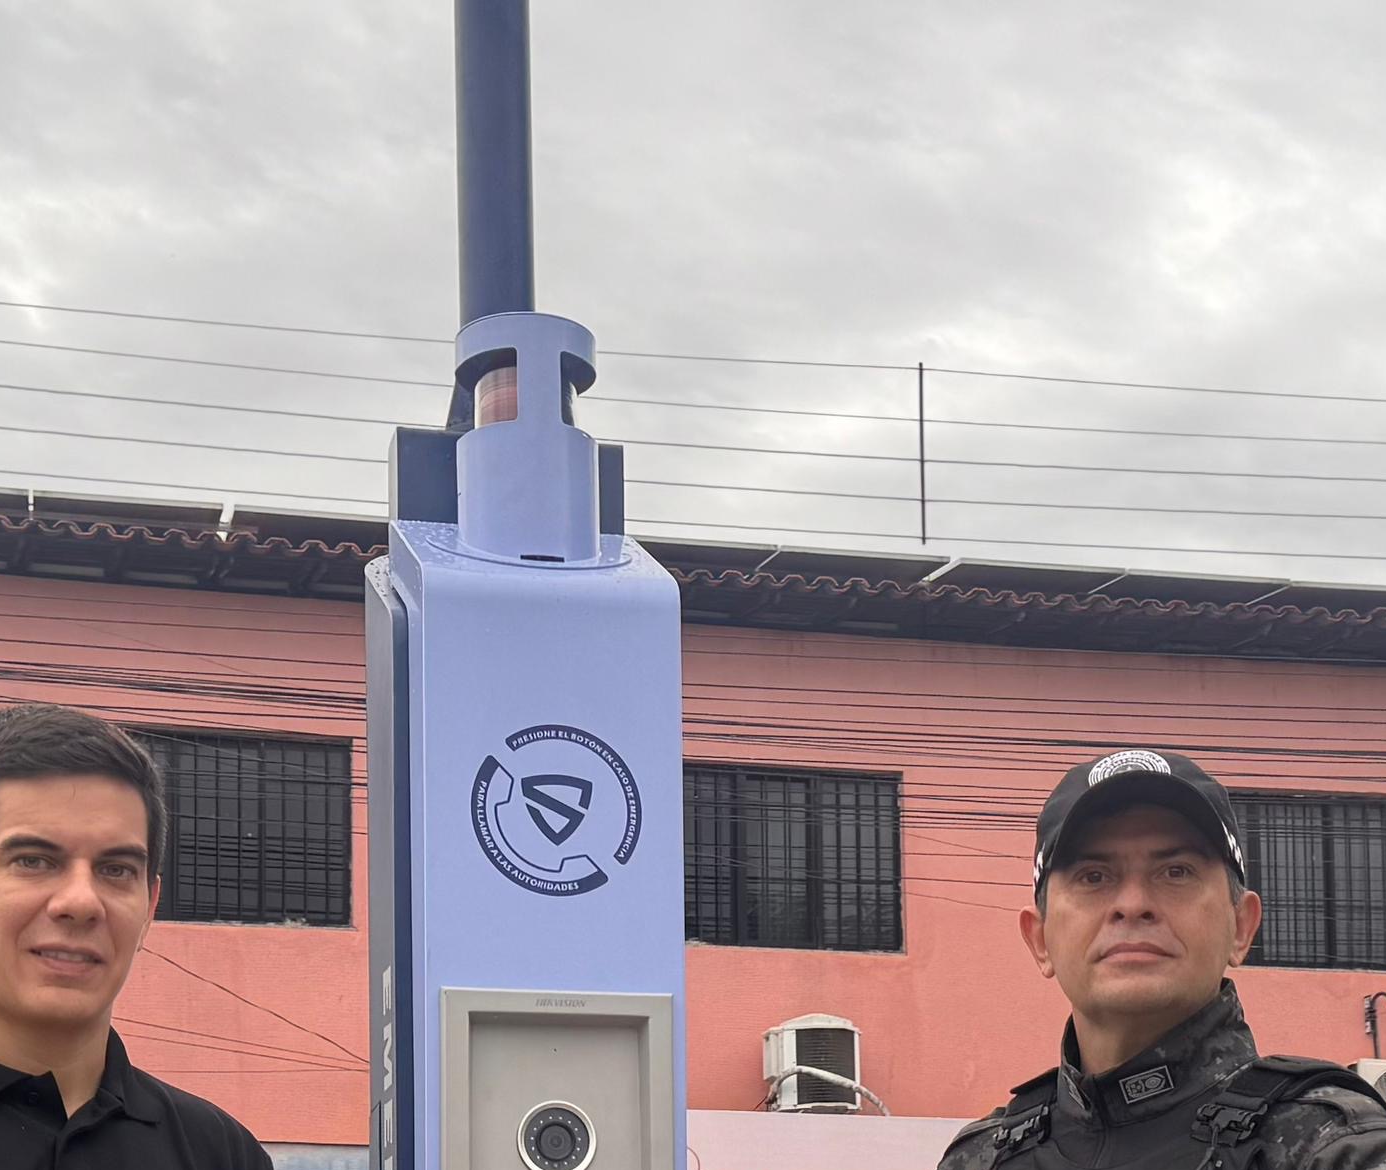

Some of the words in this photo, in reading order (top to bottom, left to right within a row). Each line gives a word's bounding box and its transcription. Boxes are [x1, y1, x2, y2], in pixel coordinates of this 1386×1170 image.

[512, 730, 557, 748] PRESIONE
[558, 730, 570, 739] EL
[571, 733, 603, 753] BOTON
[601, 750, 614, 763] EN
[612, 761, 630, 785] CASO
[477, 780, 487, 808] PARA
[625, 785, 634, 799] DE
[477, 809, 495, 849] LLAMAR
[618, 799, 637, 859] EMERGENCIA
[490, 848, 499, 857] A
[496, 855, 512, 872] LAS
[511, 870, 580, 891] AUTORIDADES
